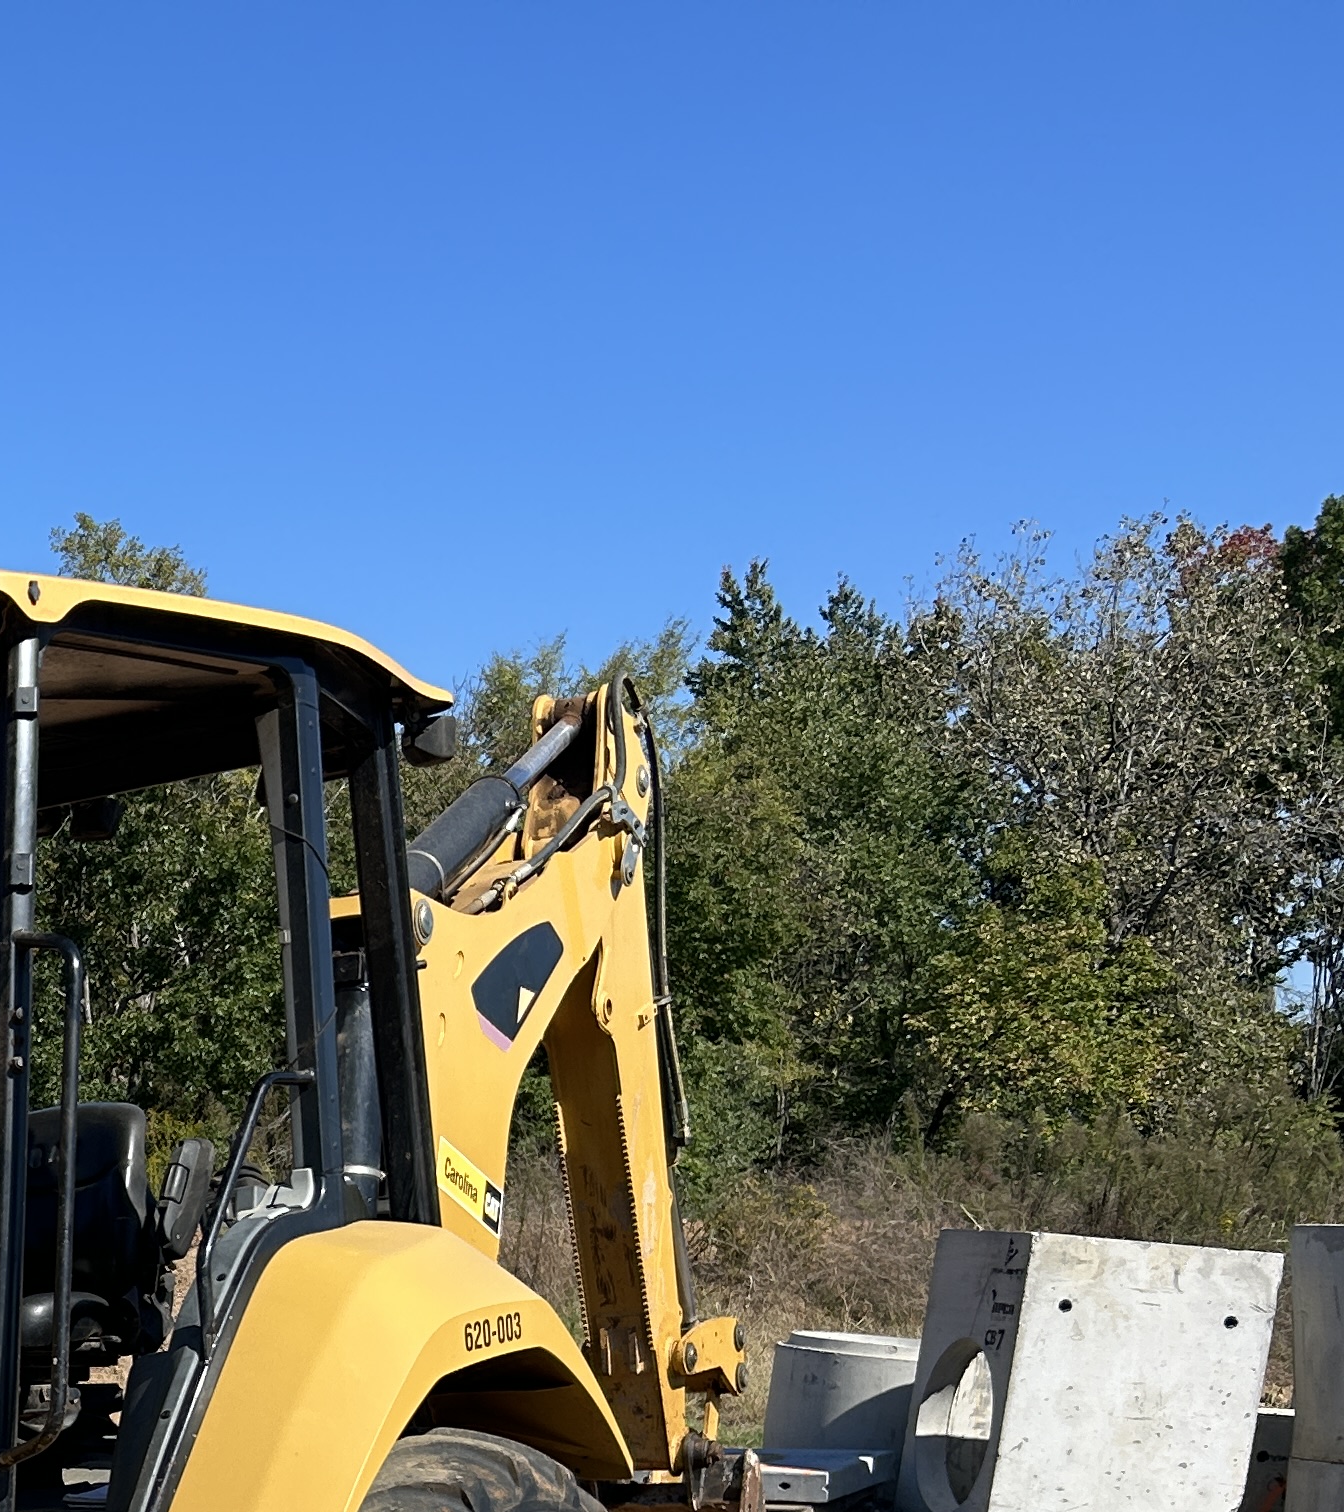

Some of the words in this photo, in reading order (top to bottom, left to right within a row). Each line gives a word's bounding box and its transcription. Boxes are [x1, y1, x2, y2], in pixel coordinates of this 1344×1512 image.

[444, 1157, 478, 1204] Carolina
[484, 1191, 502, 1223] CAT
[464, 1311, 522, 1352] 620-003
